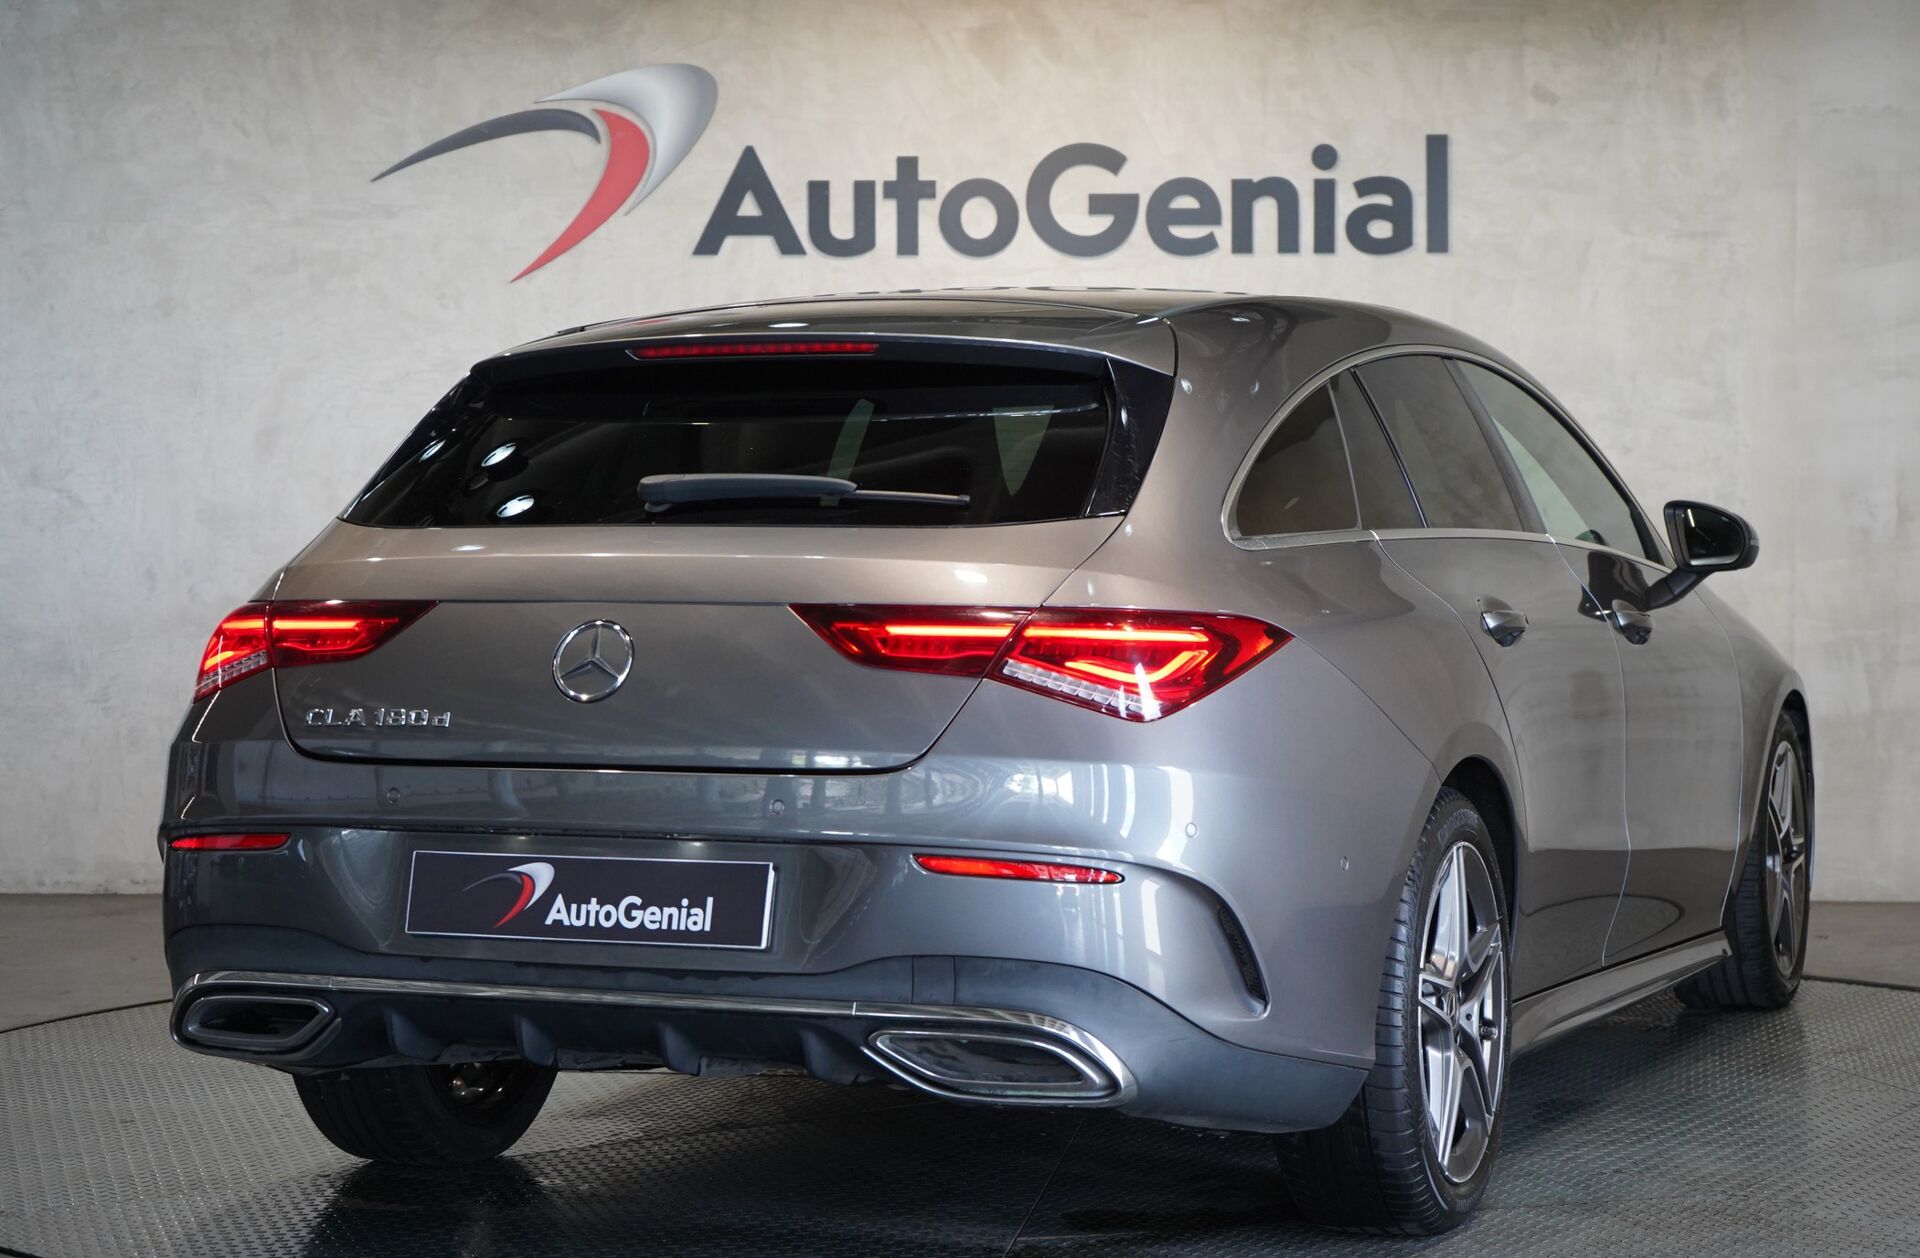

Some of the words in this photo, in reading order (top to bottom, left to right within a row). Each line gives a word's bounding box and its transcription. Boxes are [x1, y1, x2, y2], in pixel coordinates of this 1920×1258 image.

[692, 134, 1449, 257] AutoGenial
[305, 708, 366, 727] CLA
[544, 893, 714, 932] AutoGenial
